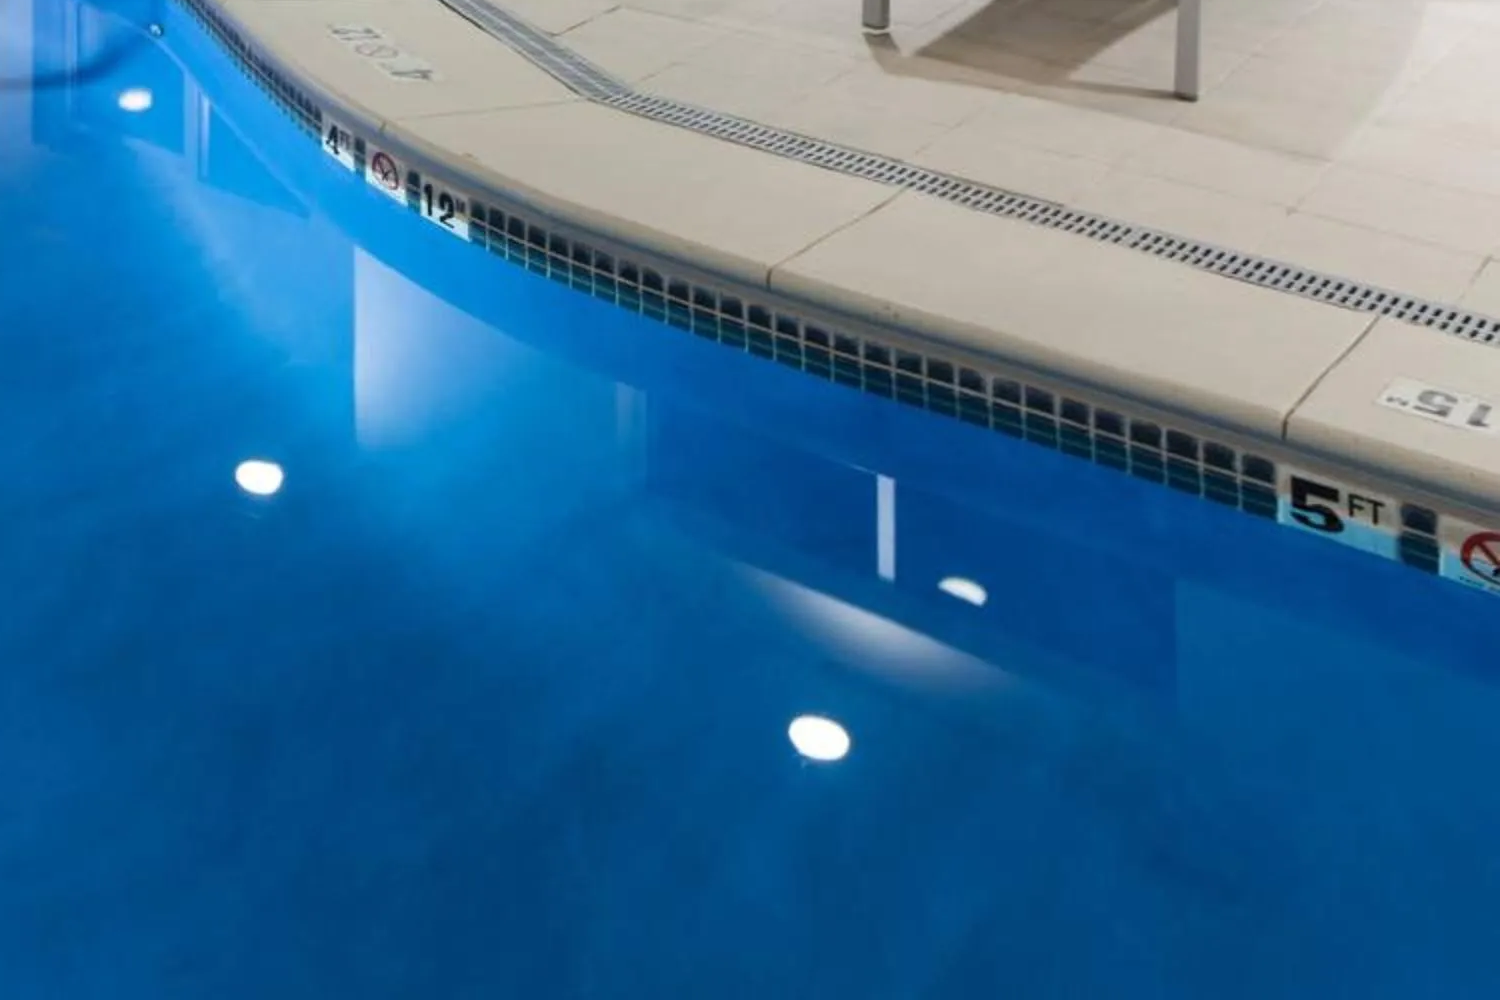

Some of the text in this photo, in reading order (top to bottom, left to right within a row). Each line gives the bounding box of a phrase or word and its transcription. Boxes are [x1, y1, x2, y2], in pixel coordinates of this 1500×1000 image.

[424, 183, 455, 229] 12
[1290, 475, 1386, 534] 5 FT
